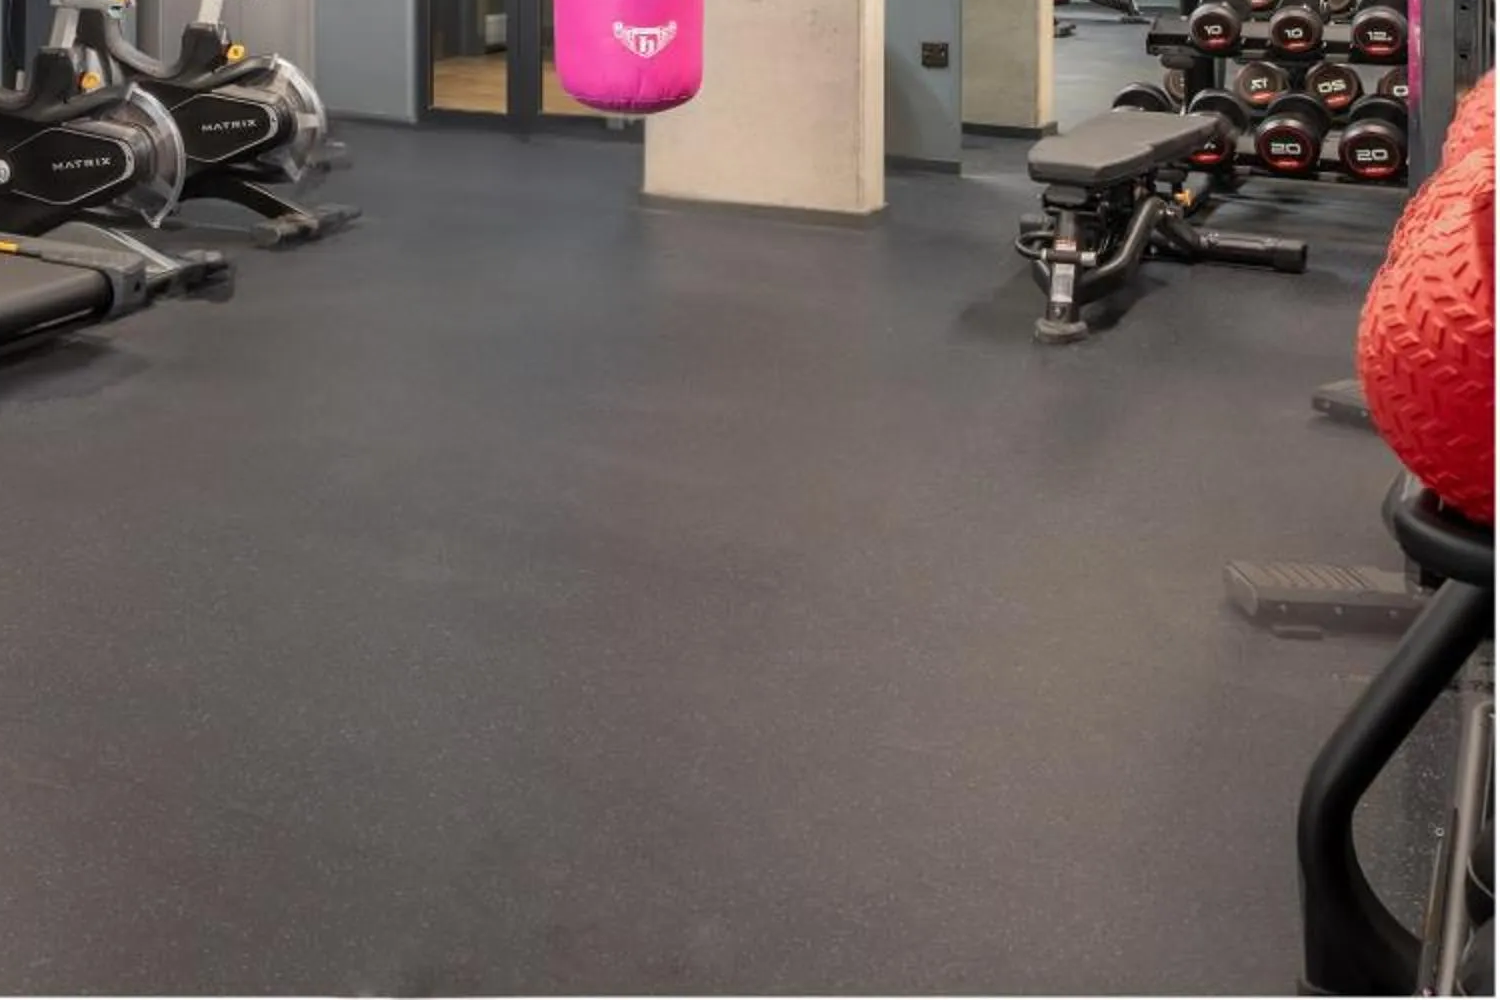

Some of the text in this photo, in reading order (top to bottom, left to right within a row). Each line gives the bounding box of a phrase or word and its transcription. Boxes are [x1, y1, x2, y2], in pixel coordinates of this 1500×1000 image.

[201, 118, 258, 132] MATRIX
[1270, 142, 1302, 156] 20
[1356, 148, 1389, 162] 20
[51, 156, 112, 172] MATRIX
